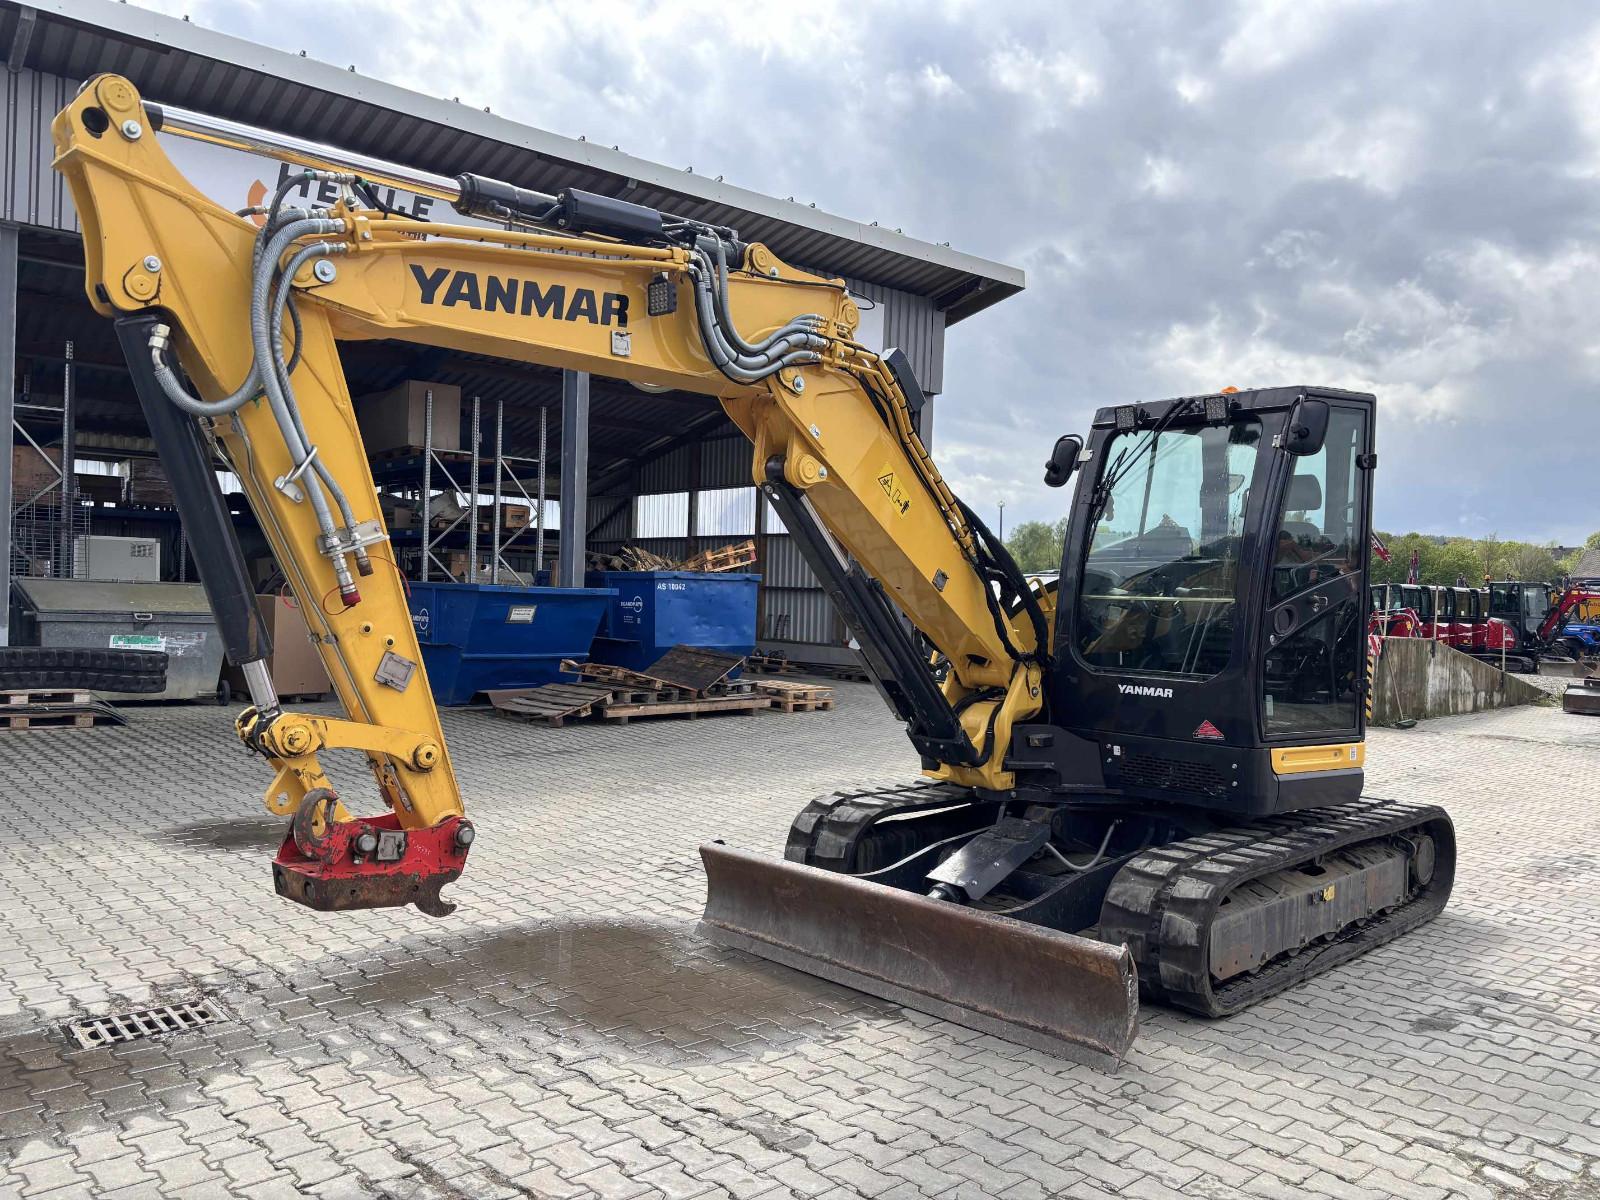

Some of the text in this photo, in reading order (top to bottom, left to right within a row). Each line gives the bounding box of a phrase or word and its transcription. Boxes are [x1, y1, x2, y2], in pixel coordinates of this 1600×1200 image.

[409, 263, 630, 328] YANMAR
[656, 582, 667, 591] AS
[1117, 684, 1174, 698] YANMAR
